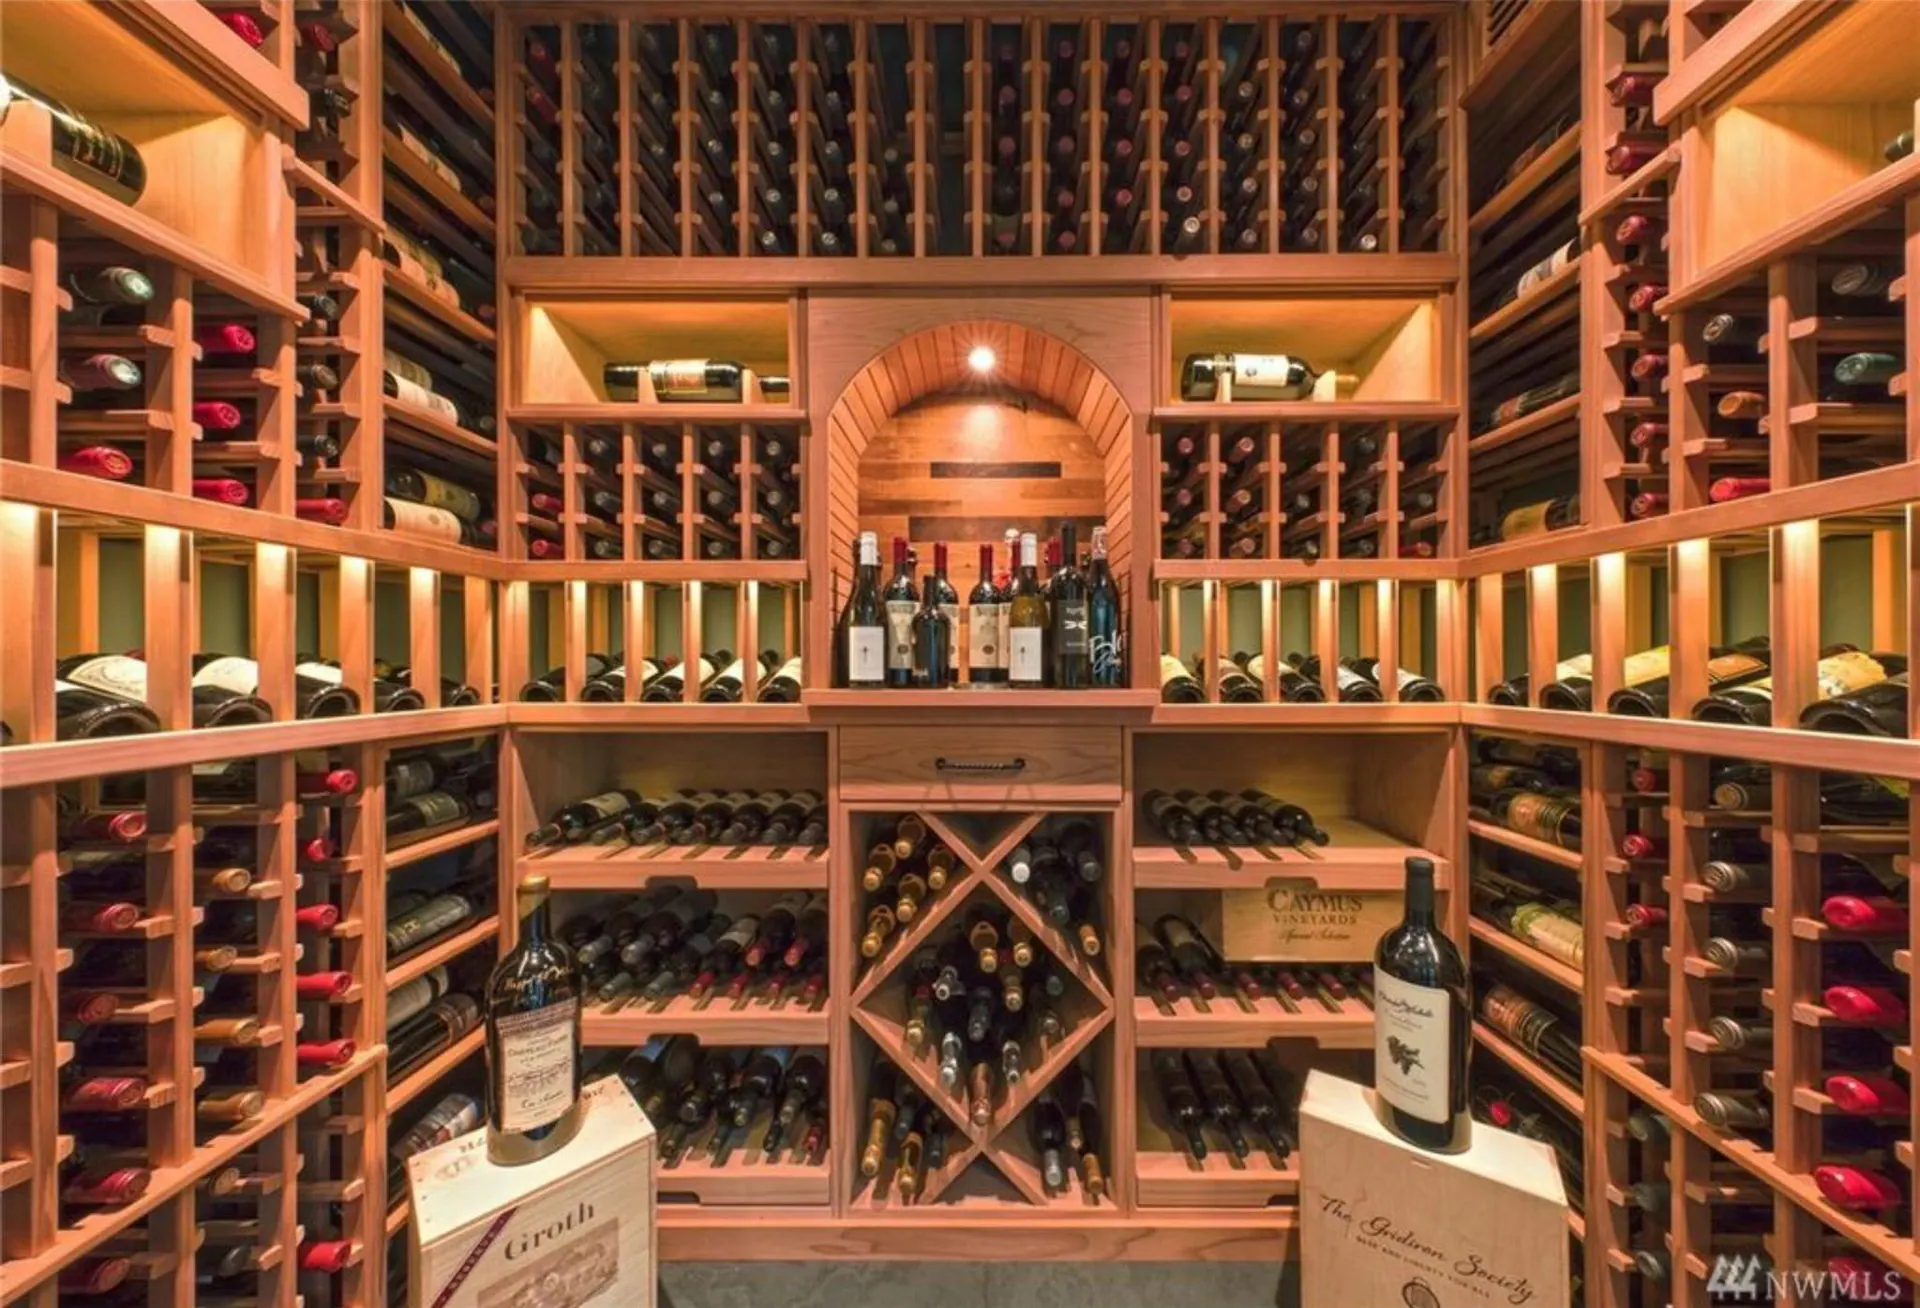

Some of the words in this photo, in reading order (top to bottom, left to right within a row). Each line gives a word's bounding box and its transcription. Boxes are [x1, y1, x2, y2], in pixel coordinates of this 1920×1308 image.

[1267, 889, 1363, 912] CAYMUS
[1273, 914, 1357, 925] VINEYARDS
[504, 1202, 595, 1261] Groth
[1320, 1193, 1353, 1223] The
[1359, 1216, 1447, 1262] Gridiron
[1453, 1254, 1535, 1305] Society
